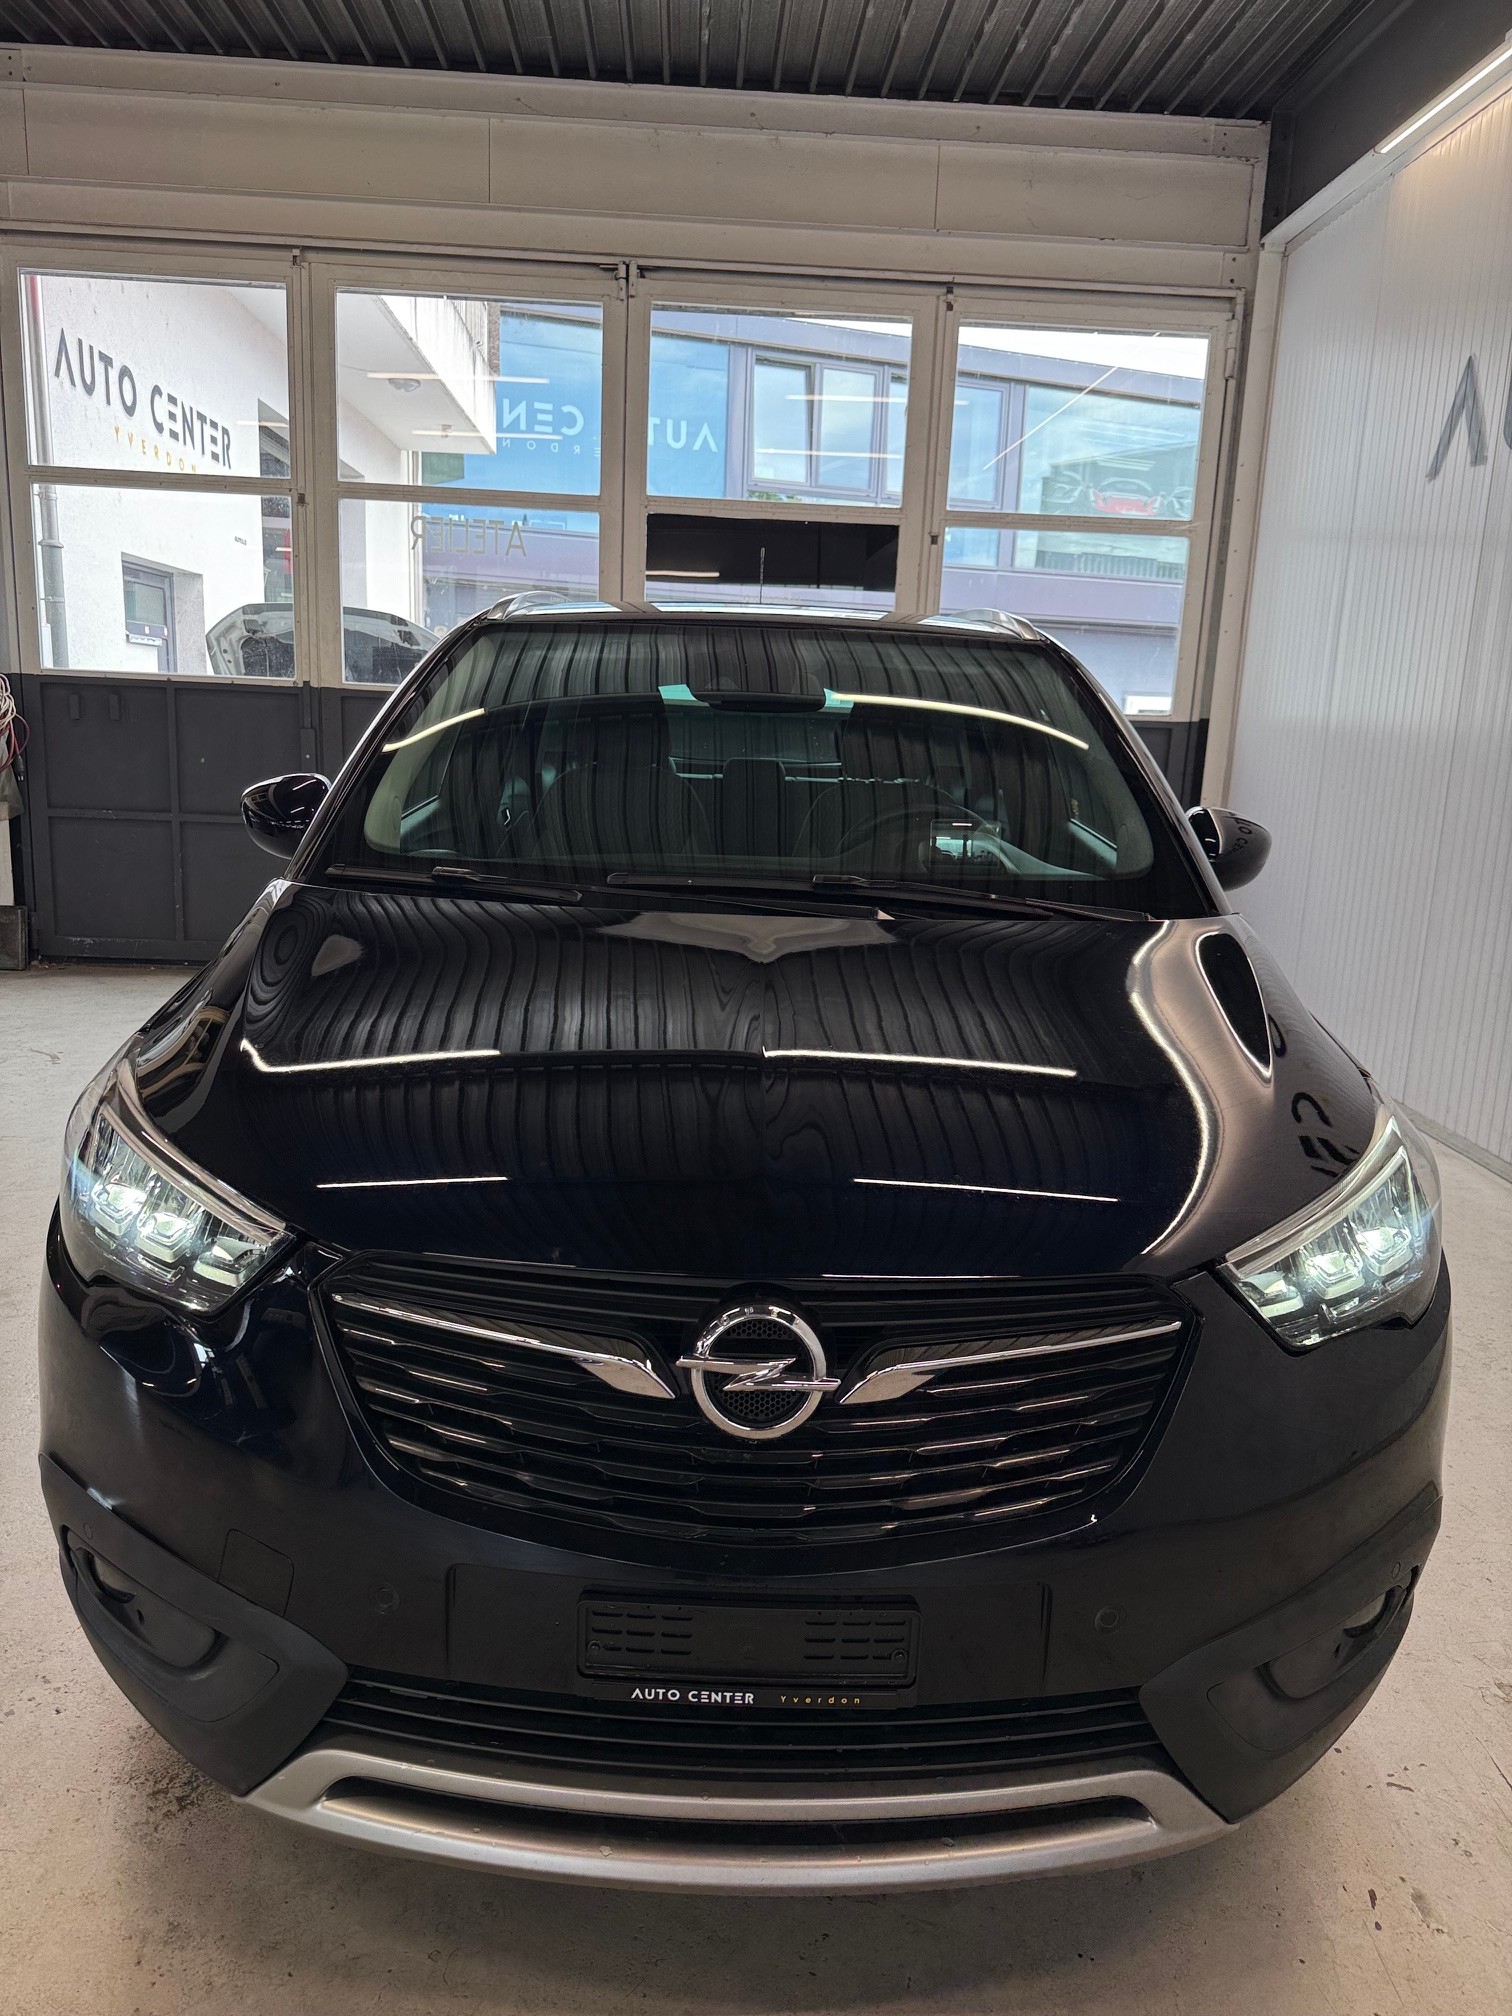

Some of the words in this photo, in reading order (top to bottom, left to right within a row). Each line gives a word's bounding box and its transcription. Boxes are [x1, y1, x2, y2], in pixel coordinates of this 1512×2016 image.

[54, 327, 138, 418] AUTO
[150, 384, 232, 470] CENTER
[114, 425, 197, 473] YVERDON
[631, 1688, 680, 1701] AUTO
[688, 1690, 755, 1705] CENTER
[780, 1695, 861, 1705] Yverdon
